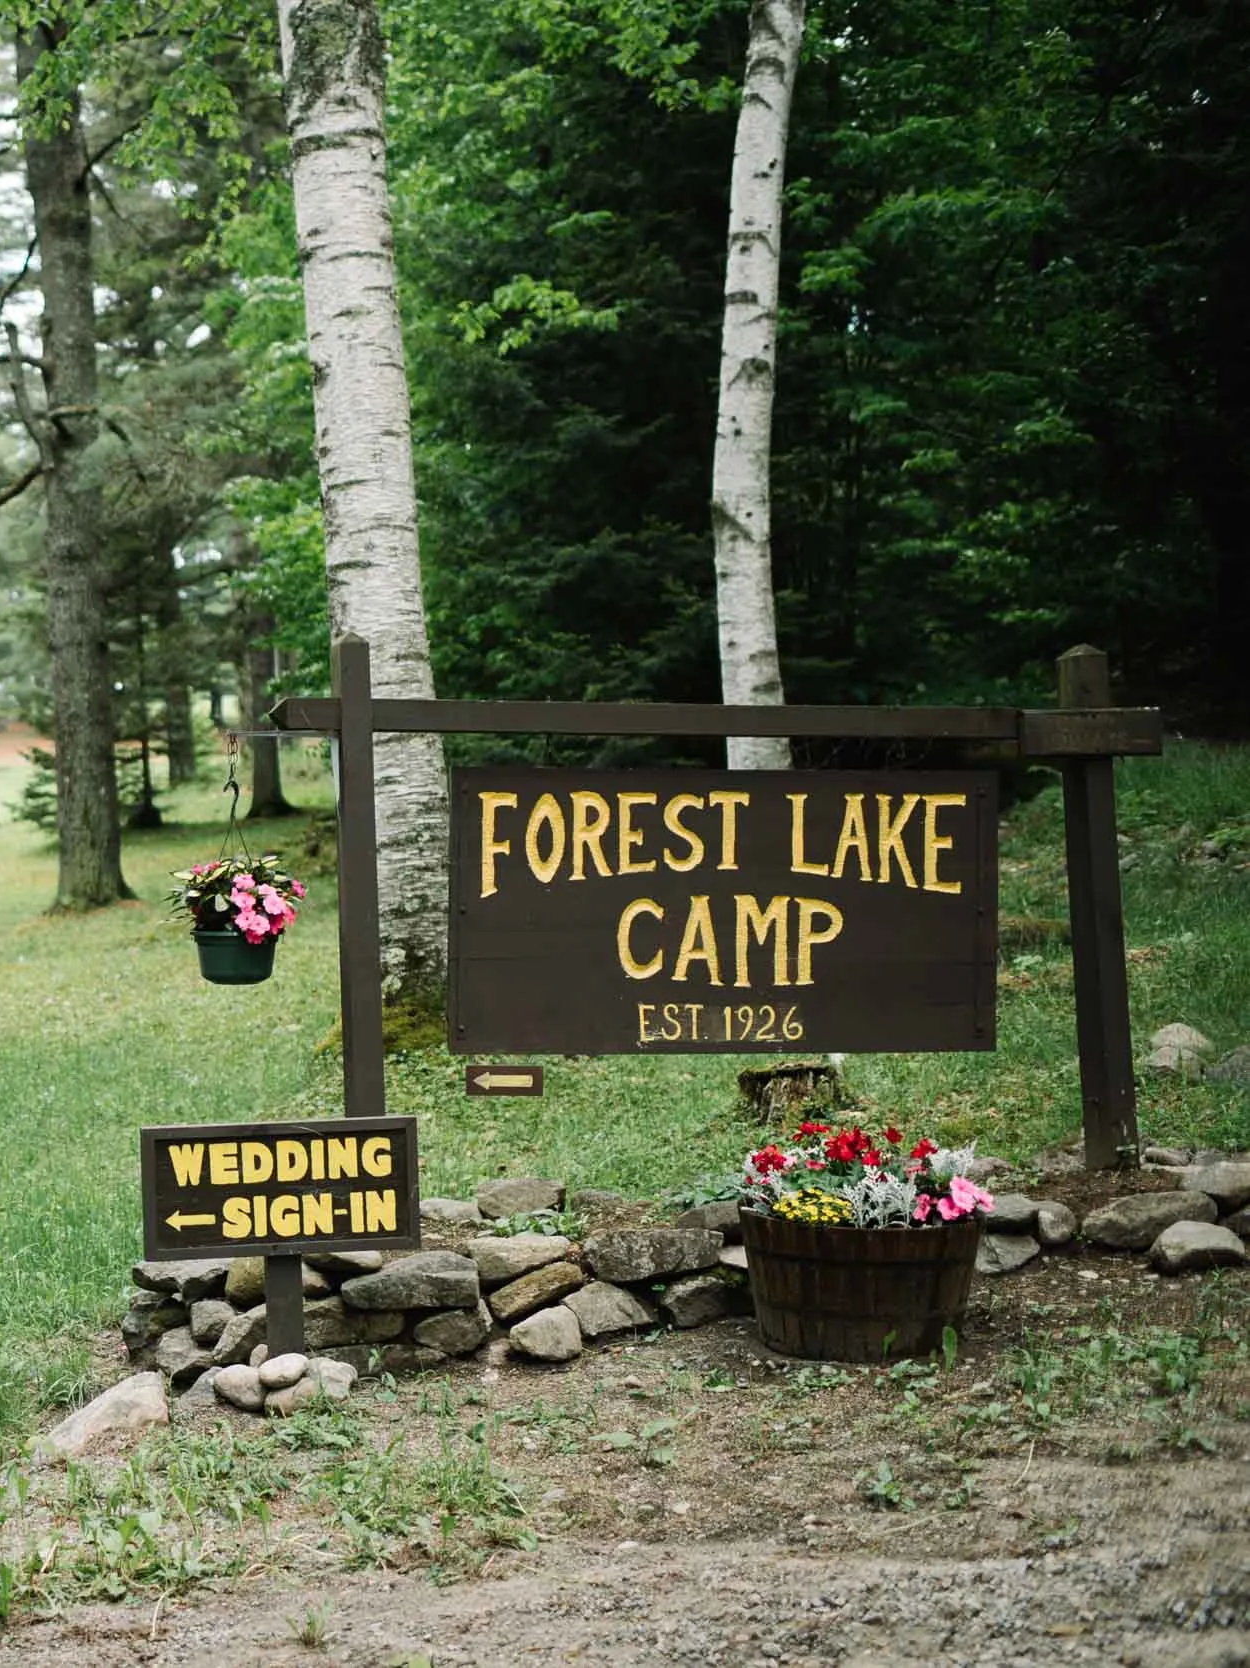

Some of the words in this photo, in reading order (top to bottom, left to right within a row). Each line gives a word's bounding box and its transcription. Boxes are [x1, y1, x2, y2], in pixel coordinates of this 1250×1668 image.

[479, 791, 749, 898] FOREST
[785, 793, 966, 894] LAKE
[617, 894, 843, 987] CAMP
[723, 1005, 804, 1041] 1926
[168, 1137, 392, 1187] WEDDING
[222, 1189, 396, 1238] SIGN-IN
